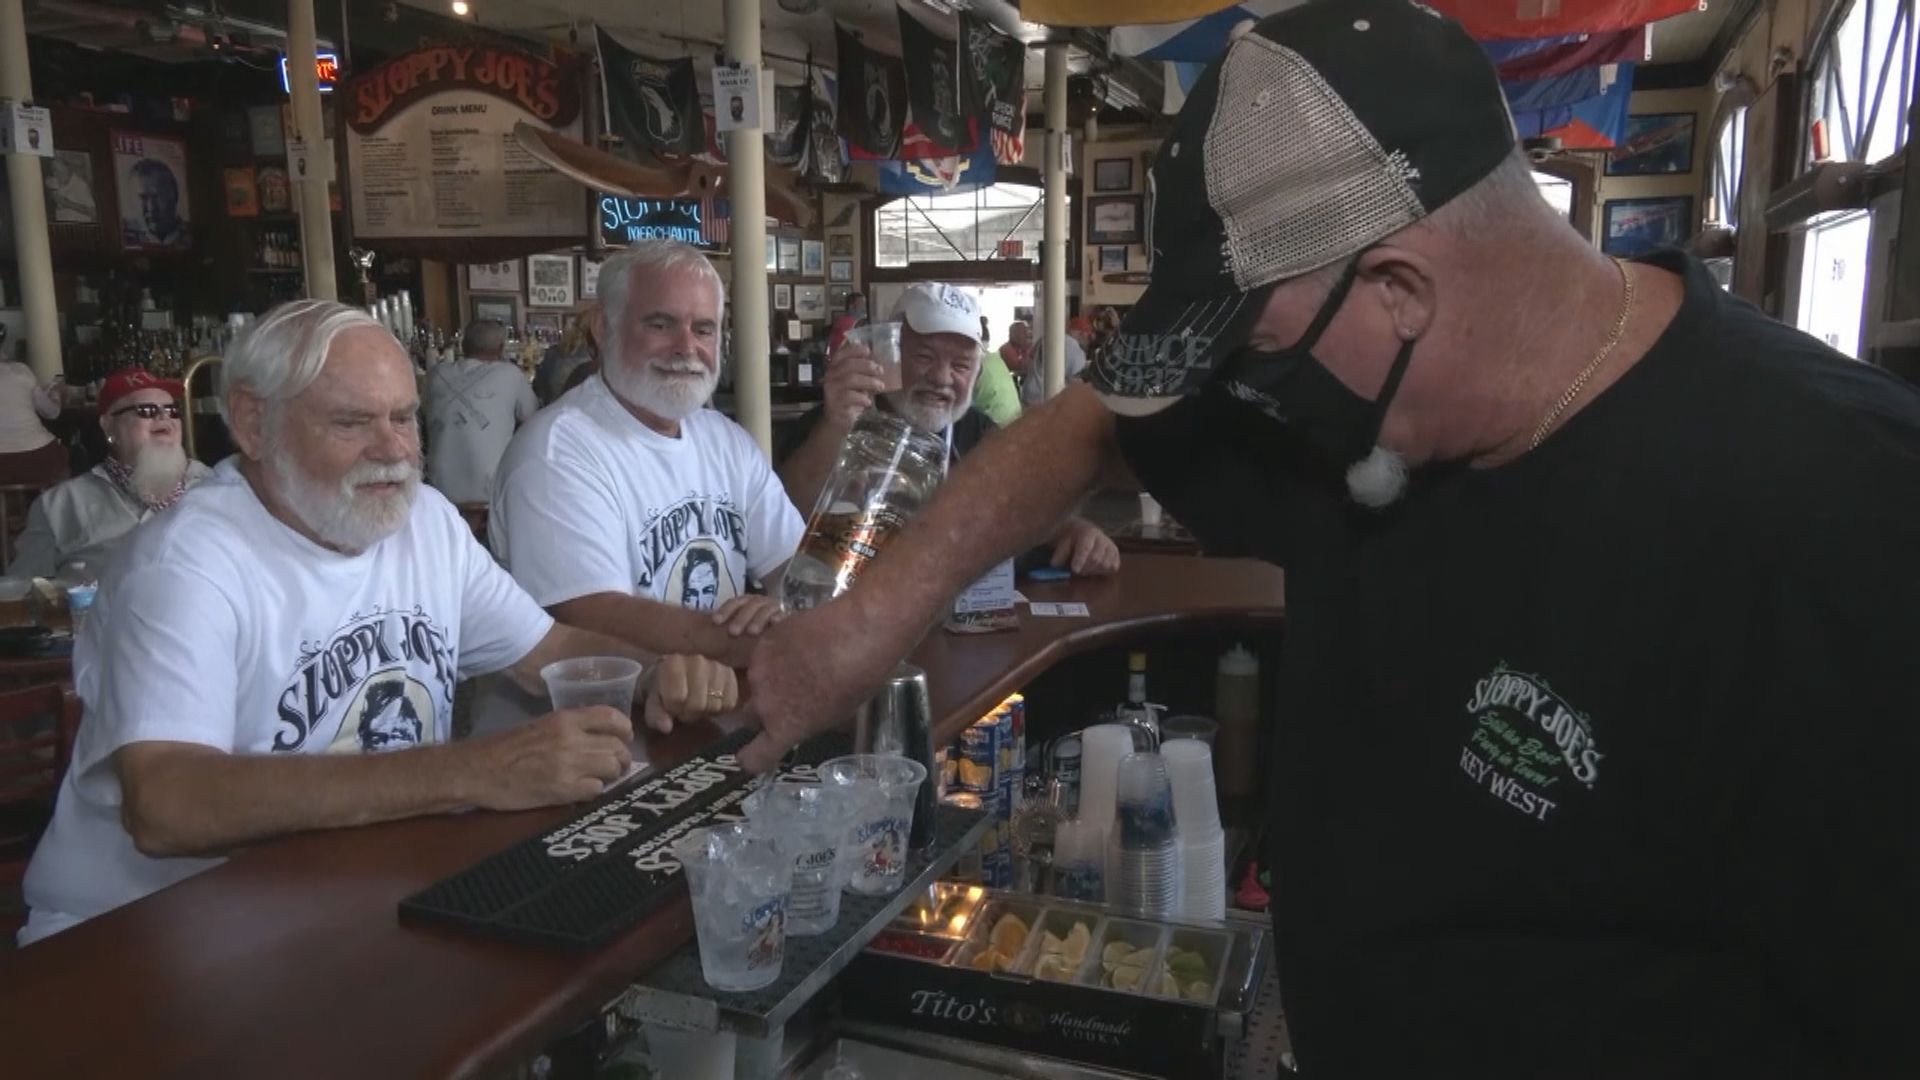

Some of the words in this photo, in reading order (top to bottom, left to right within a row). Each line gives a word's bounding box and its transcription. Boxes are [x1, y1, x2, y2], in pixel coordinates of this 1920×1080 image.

[357, 49, 472, 123] SLOPPY
[474, 51, 560, 119] JOE'S
[431, 105, 458, 116] DRINK
[460, 104, 488, 114] MENU
[601, 197, 676, 230] SLO
[272, 619, 401, 753] SLOPPY
[1466, 673, 1550, 721] SLOPPY
[1540, 703, 1604, 783] JOE'S
[1459, 746, 1494, 784] KEY
[1489, 772, 1557, 821] WEST
[911, 989, 997, 1026] Tito's
[1050, 1011, 1132, 1036] Handmade
[1061, 1027, 1121, 1047] VODKA
